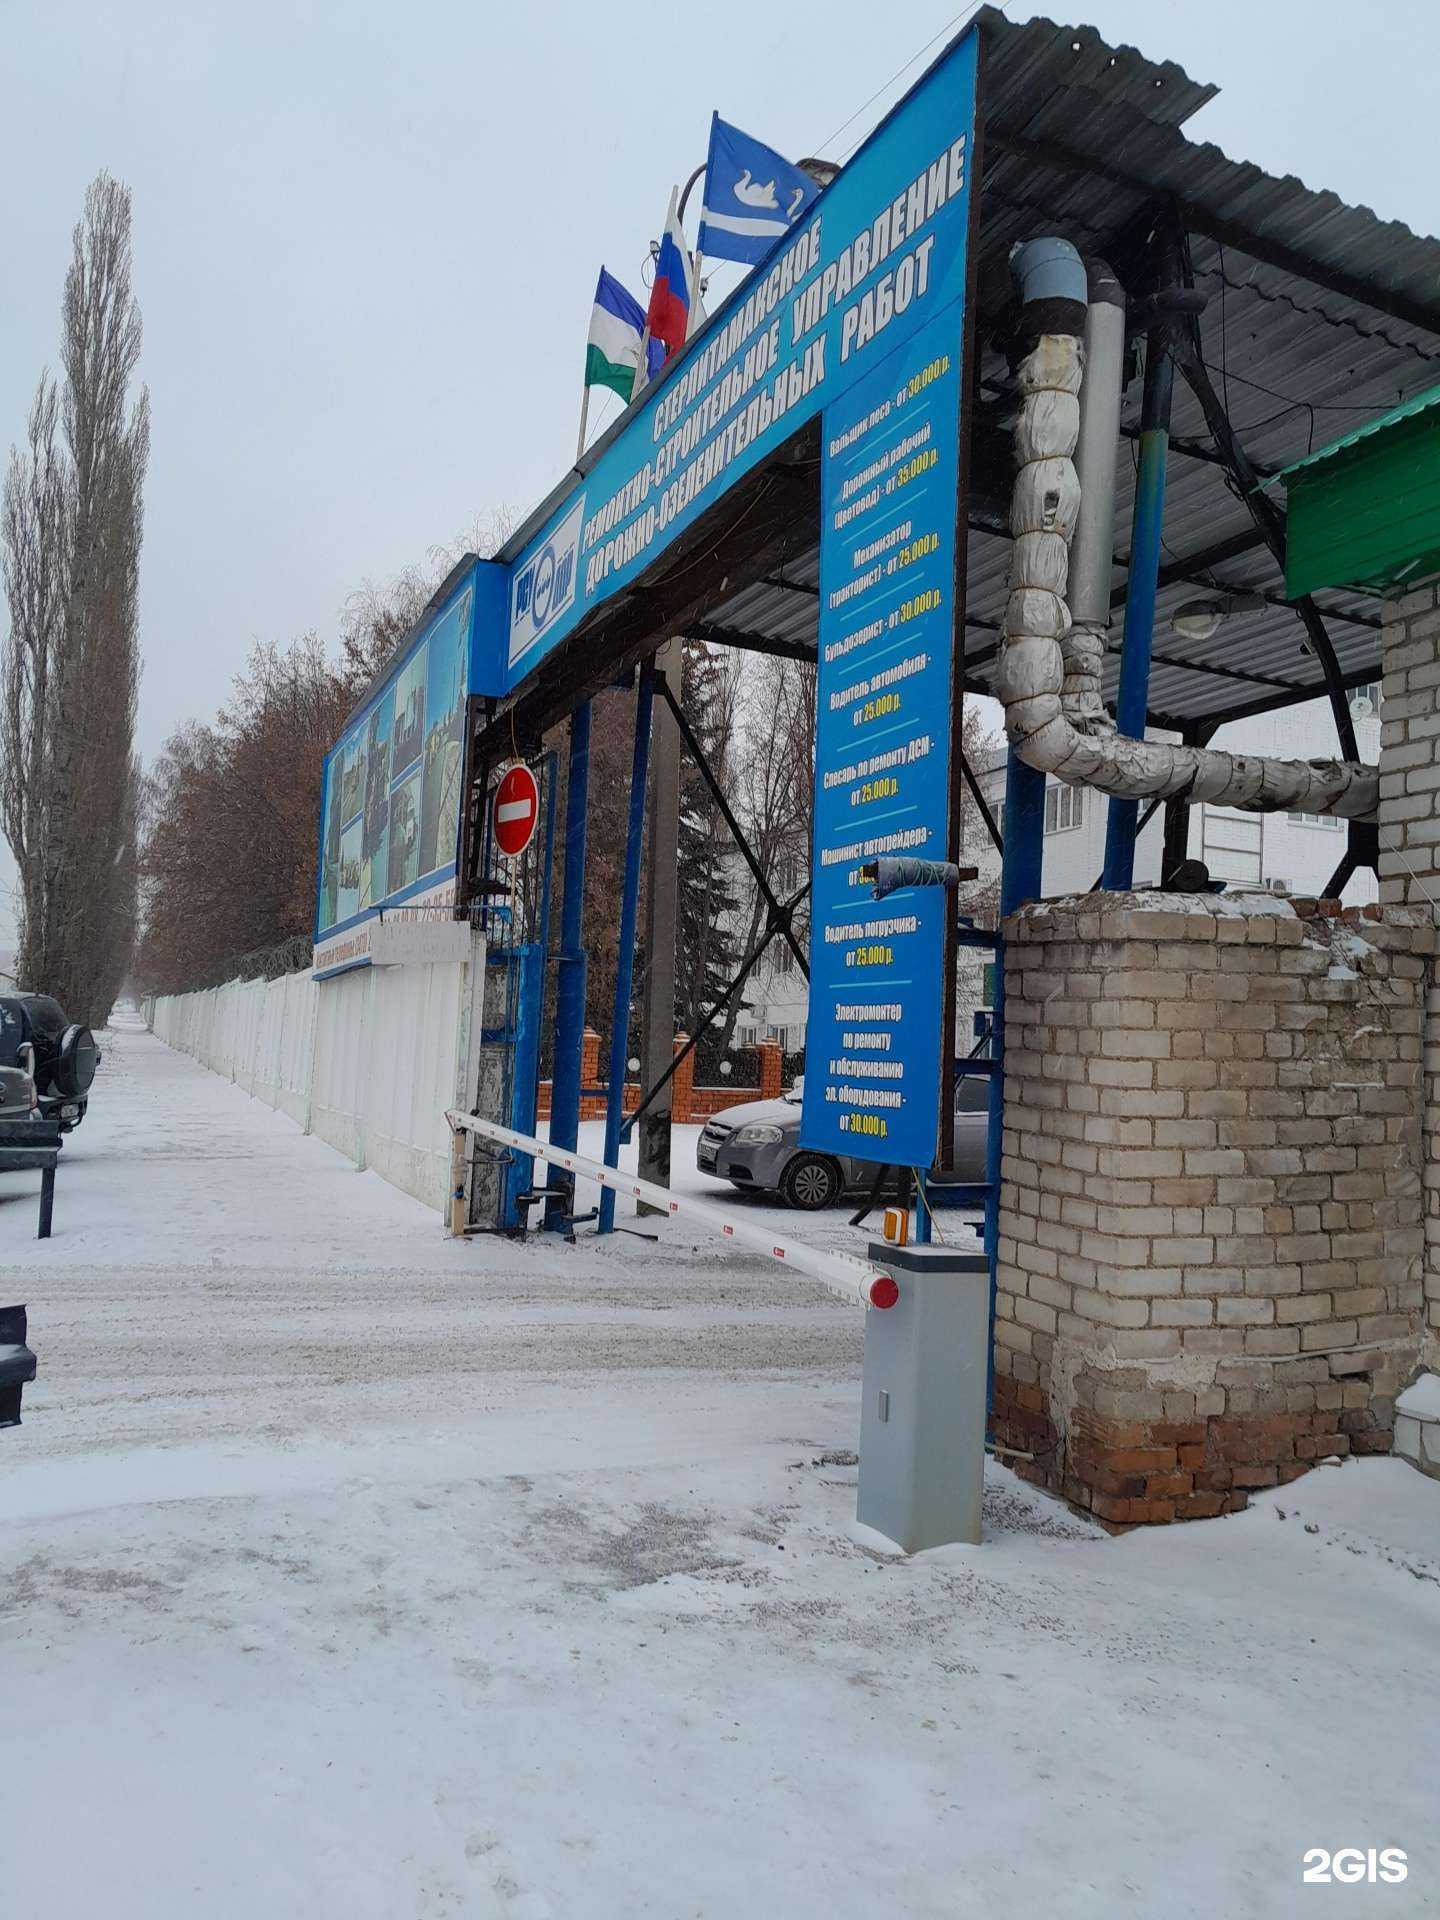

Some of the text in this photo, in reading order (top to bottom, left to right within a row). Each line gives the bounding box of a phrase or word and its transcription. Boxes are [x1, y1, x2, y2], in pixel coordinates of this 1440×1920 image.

[582, 131, 967, 555] РЕМОНТНО-СТРОИТЕЛЬНОЕ УПРАВЛЕНИЕ
[652, 215, 822, 443] СТЕРЛИТАМАКСКОЕ
[584, 232, 935, 594] ДОРОЖНО-ОЗЕЛЕНИТЕЛЬНЫХ РАБОТ
[829, 416, 869, 458] Вальщик
[868, 400, 890, 429] леса
[896, 386, 907, 408] от
[908, 358, 940, 399] 30.000
[842, 420, 931, 501] Дорожный рабочий
[886, 475, 897, 495] от
[897, 450, 929, 487] 35.000
[853, 520, 912, 569] Механизатор
[829, 563, 882, 609] (тракторист)
[887, 556, 898, 575] от
[898, 534, 930, 569] 25.000
[824, 619, 884, 662] Бульдозерист
[888, 609, 900, 629] от
[900, 590, 932, 623] 30.000
[830, 680, 870, 711] Водитель
[870, 653, 927, 691] автомобиля
[853, 708, 864, 726] от
[863, 693, 892, 722] 25.000
[823, 765, 857, 789] Слесарь
[857, 760, 869, 777] по
[869, 746, 907, 776] ремонту
[907, 735, 930, 763] ДСМ
[851, 789, 861, 806] от
[861, 777, 890, 803] 25.000
[821, 844, 863, 866] Машинист
[864, 826, 928, 856] автогрейдера
[848, 869, 859, 886] от
[824, 923, 864, 943] Водитель
[864, 915, 917, 938] погрузчика
[846, 951, 856, 967] от
[856, 945, 885, 965] 25.000
[835, 1003, 902, 1022] Электромонтер
[842, 1032, 892, 1051] по ремонту
[829, 1057, 904, 1079] и обслуживанию
[825, 1086, 838, 1102] эл.
[838, 1084, 901, 1109] оборудования
[839, 1115, 850, 1131] от
[850, 1113, 879, 1136] 30.000
